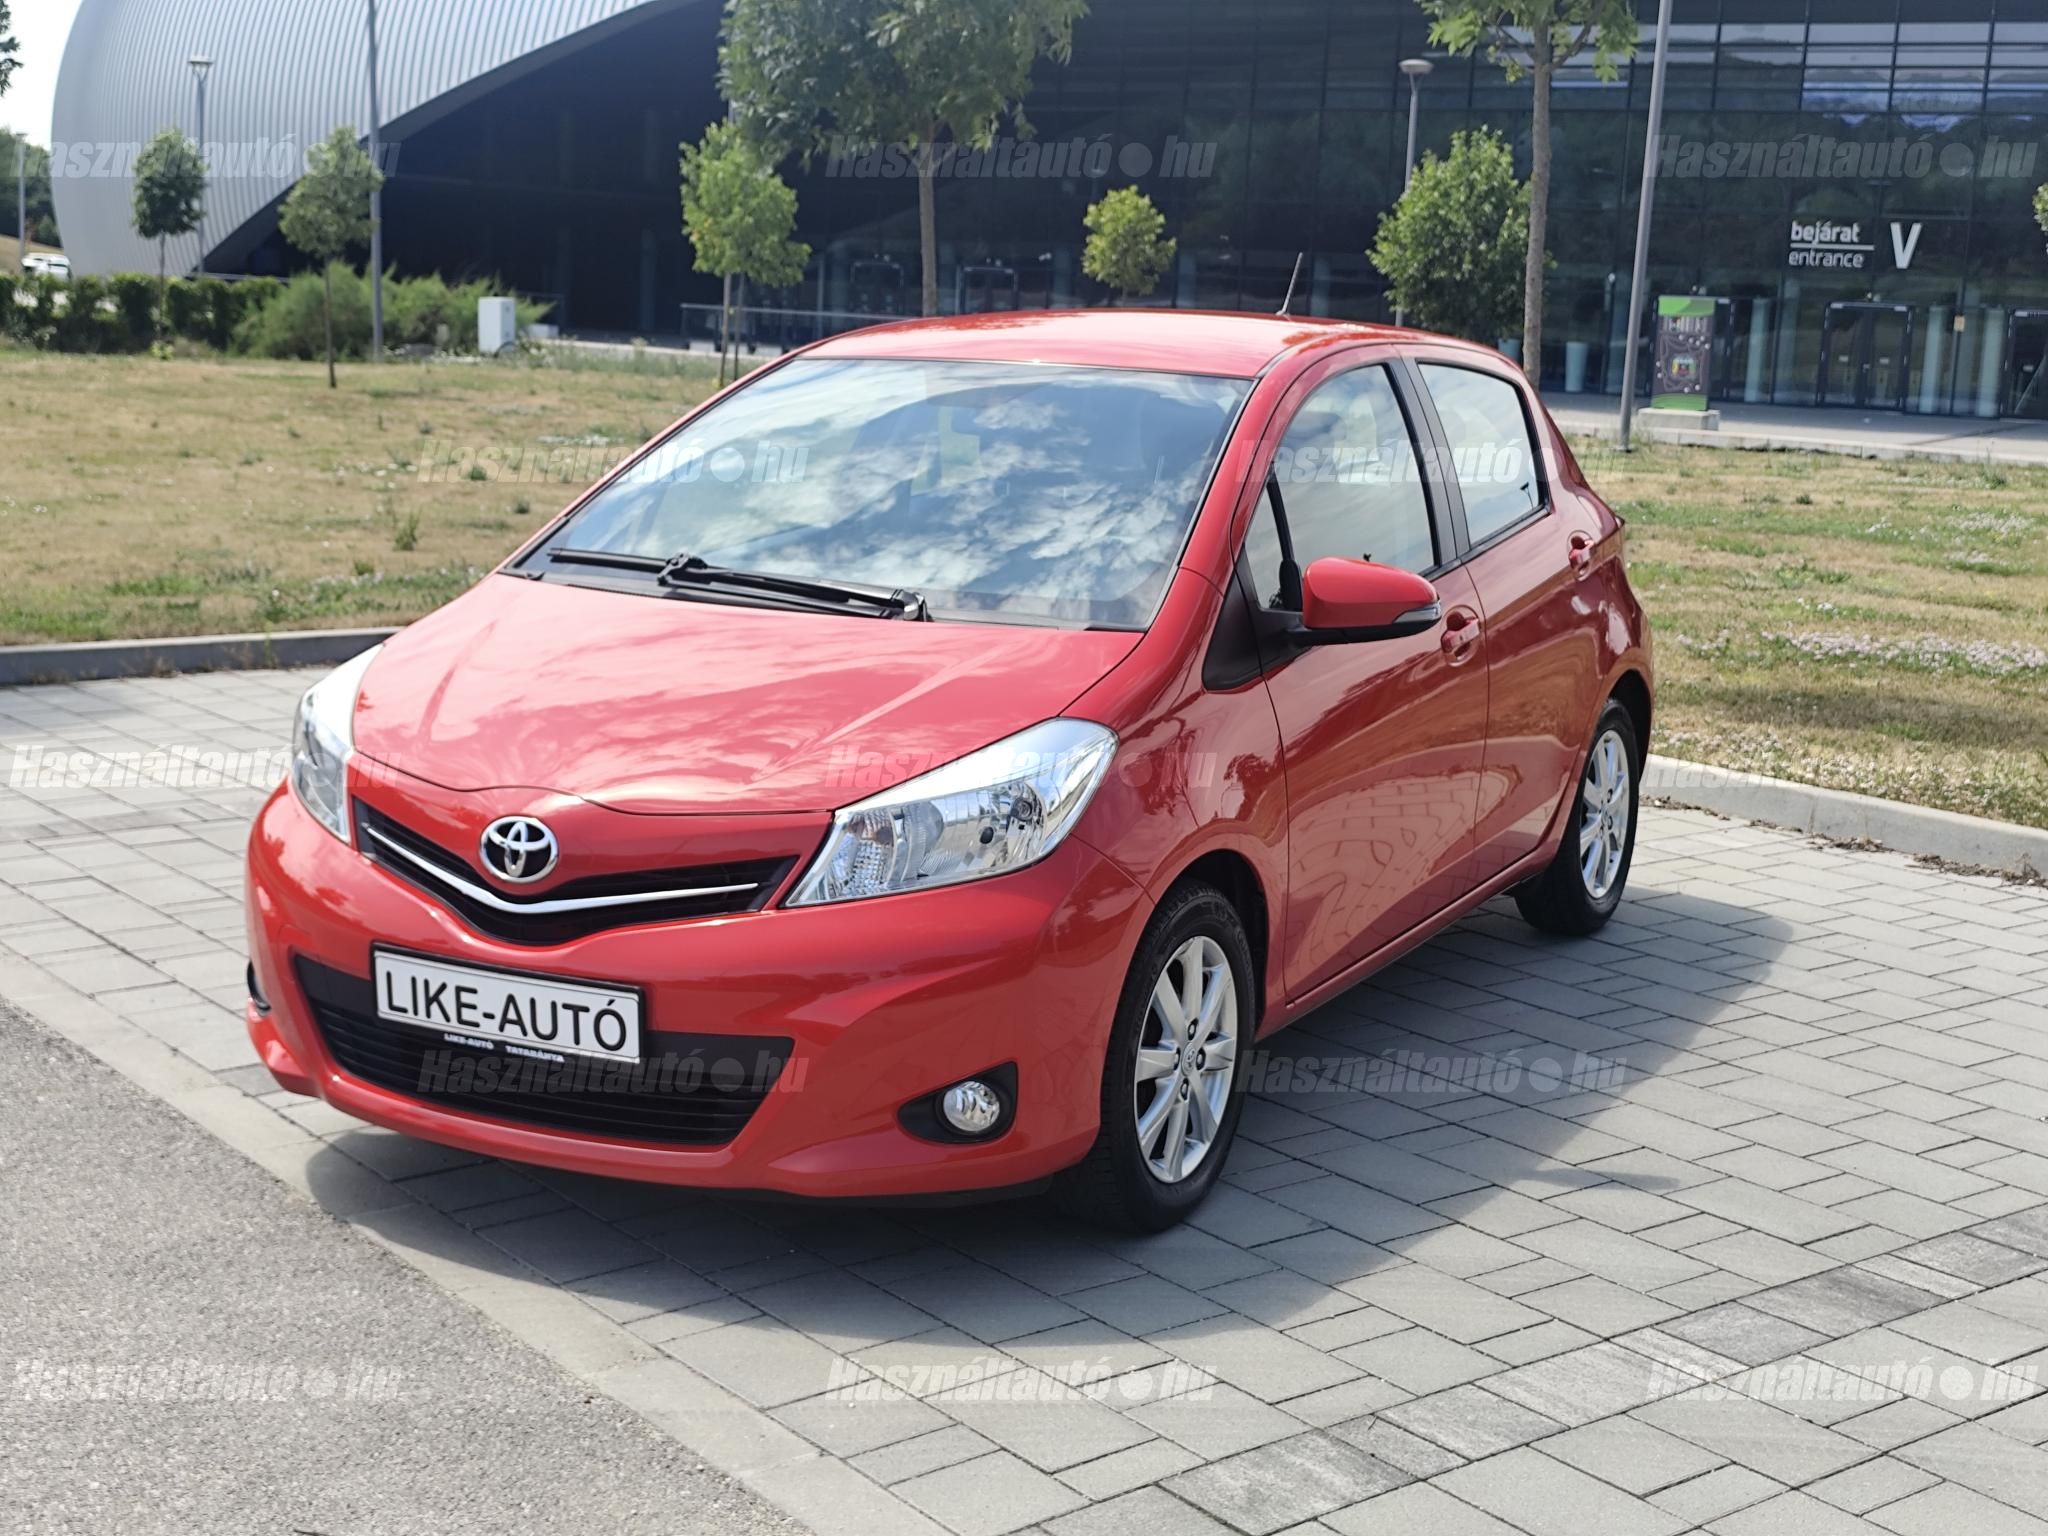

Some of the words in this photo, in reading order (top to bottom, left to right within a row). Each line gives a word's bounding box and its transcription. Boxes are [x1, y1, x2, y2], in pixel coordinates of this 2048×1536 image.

[1791, 221, 1860, 245] bejárat
[1890, 222, 1922, 269] V
[1789, 250, 1864, 268] entrance
[386, 970, 627, 1051] LIKE-AUTÓ
